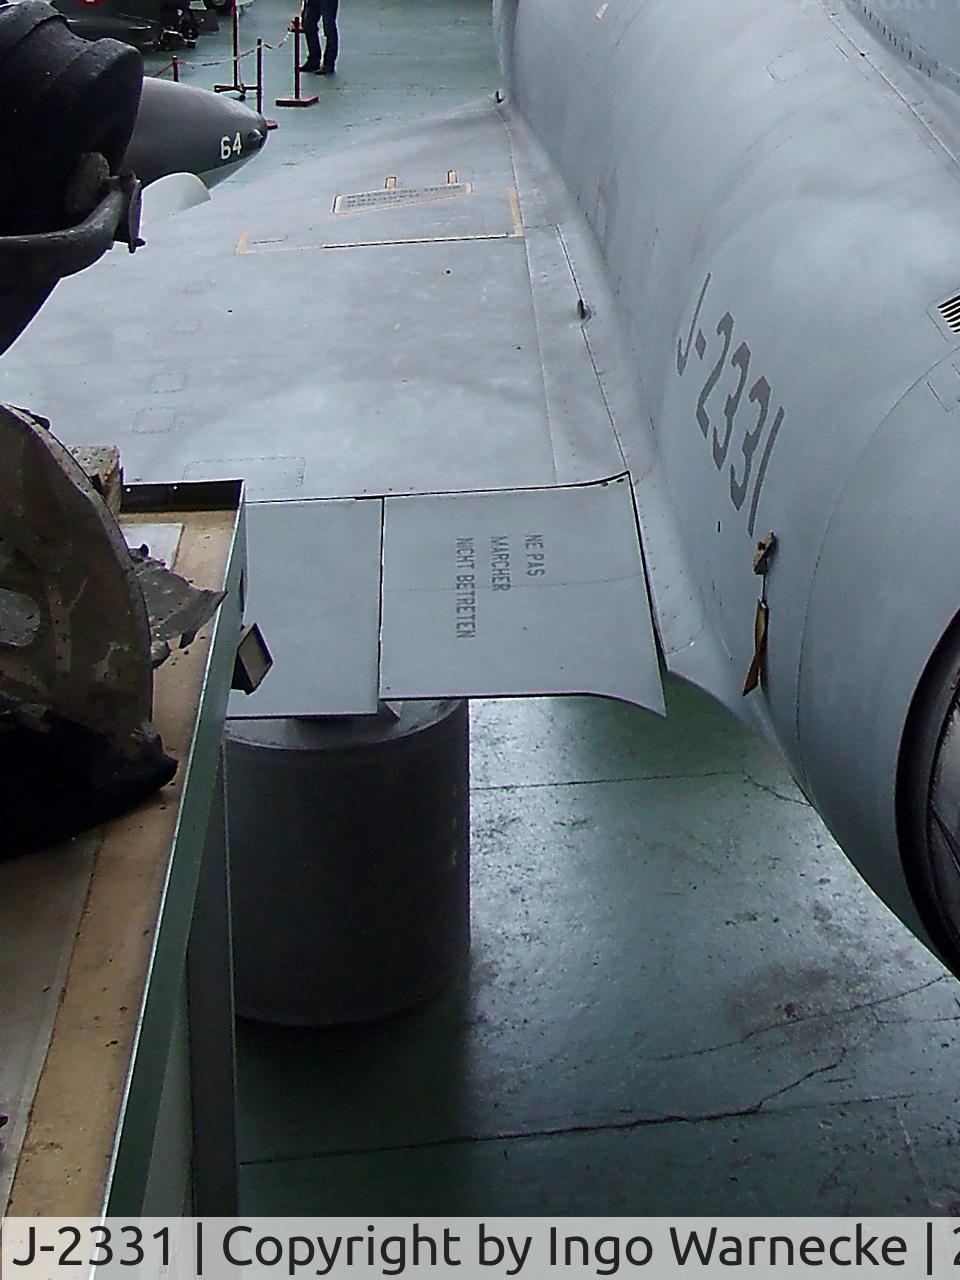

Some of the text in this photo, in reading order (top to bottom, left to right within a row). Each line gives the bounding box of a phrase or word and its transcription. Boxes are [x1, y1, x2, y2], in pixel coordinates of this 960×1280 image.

[220, 132, 242, 160] 64
[676, 272, 785, 538] J-2331
[490, 535, 512, 592] MARCHER
[525, 534, 546, 577] NE PAS
[456, 537, 476, 639] NICHT BETRETEN
